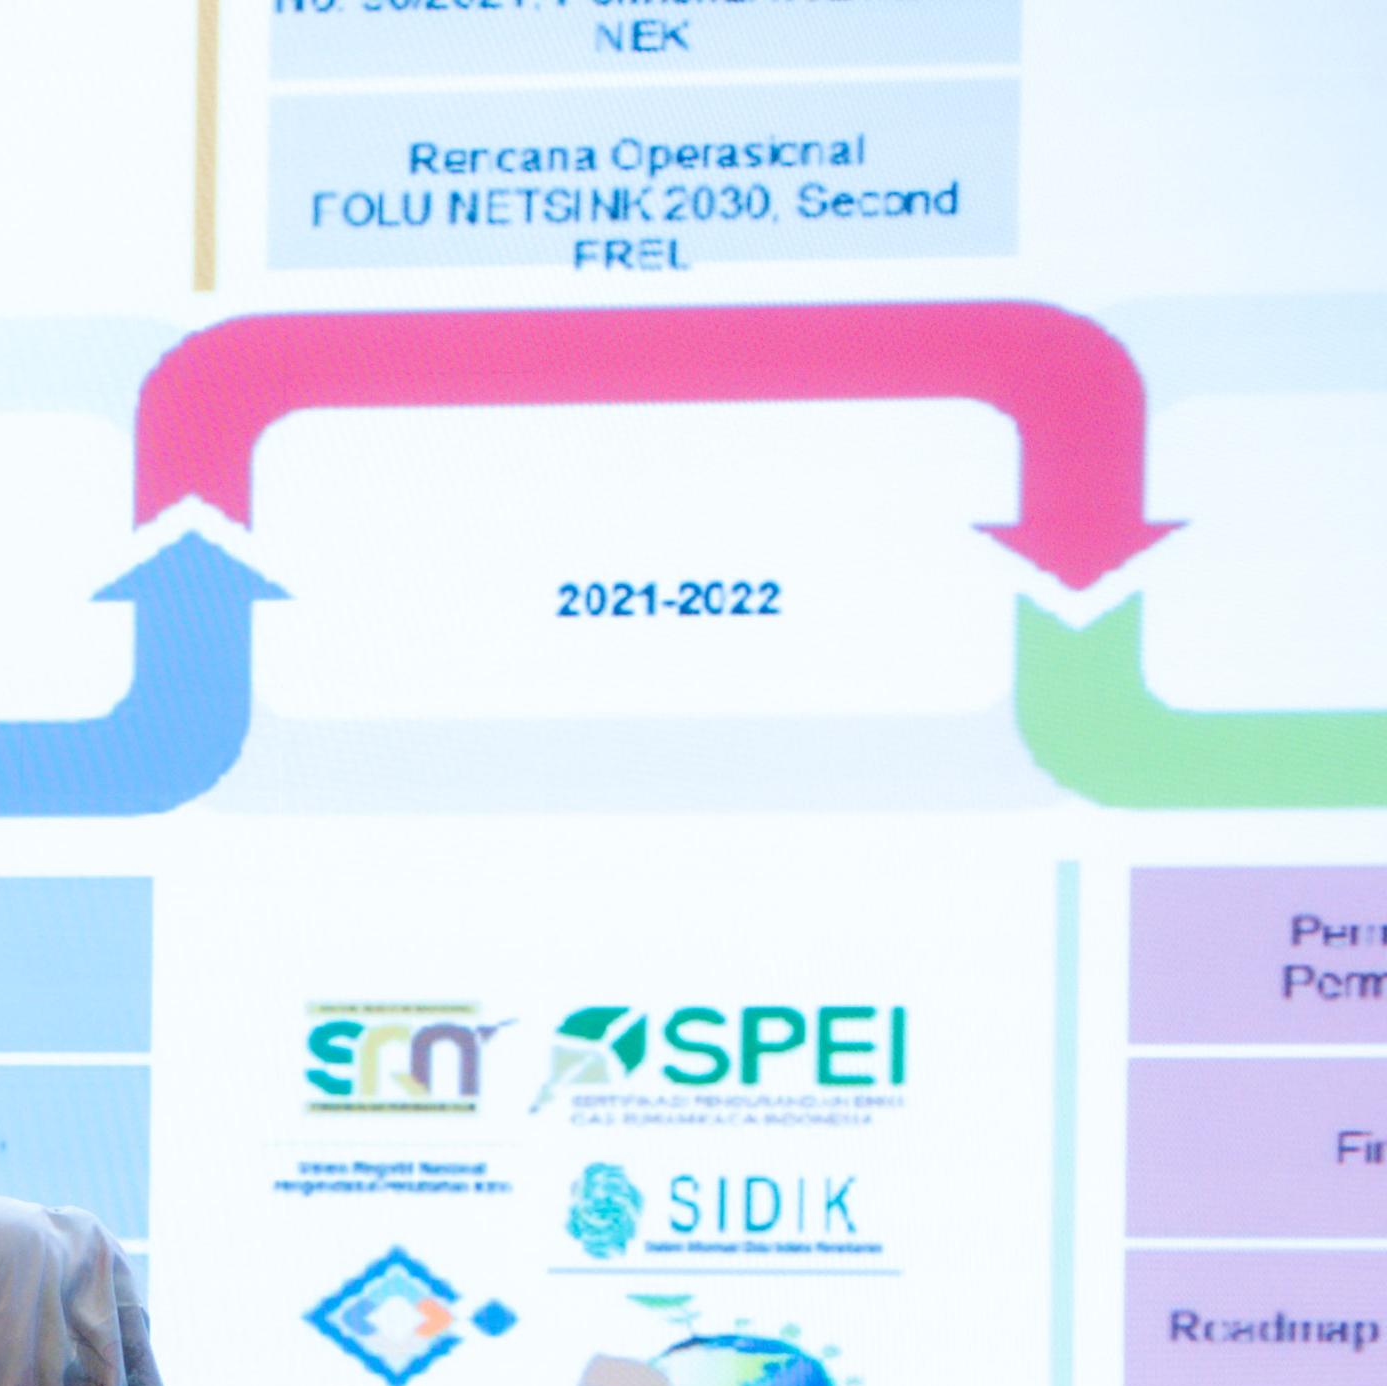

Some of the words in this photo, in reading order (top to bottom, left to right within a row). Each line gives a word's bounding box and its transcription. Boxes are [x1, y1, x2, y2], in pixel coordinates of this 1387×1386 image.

[596, 18, 690, 53] NEK
[409, 140, 598, 175] Rencana
[610, 134, 866, 178] Operasional
[311, 190, 430, 228] FOLU
[447, 186, 657, 227] NETSINK
[664, 184, 780, 225] 2030,
[796, 180, 960, 220] Second
[573, 238, 691, 271] FREL
[556, 580, 781, 617] 2021-2022
[661, 1005, 908, 1088] SPEI
[669, 1173, 858, 1235] SIDIK
[1169, 1308, 1380, 1353] Roadmap
